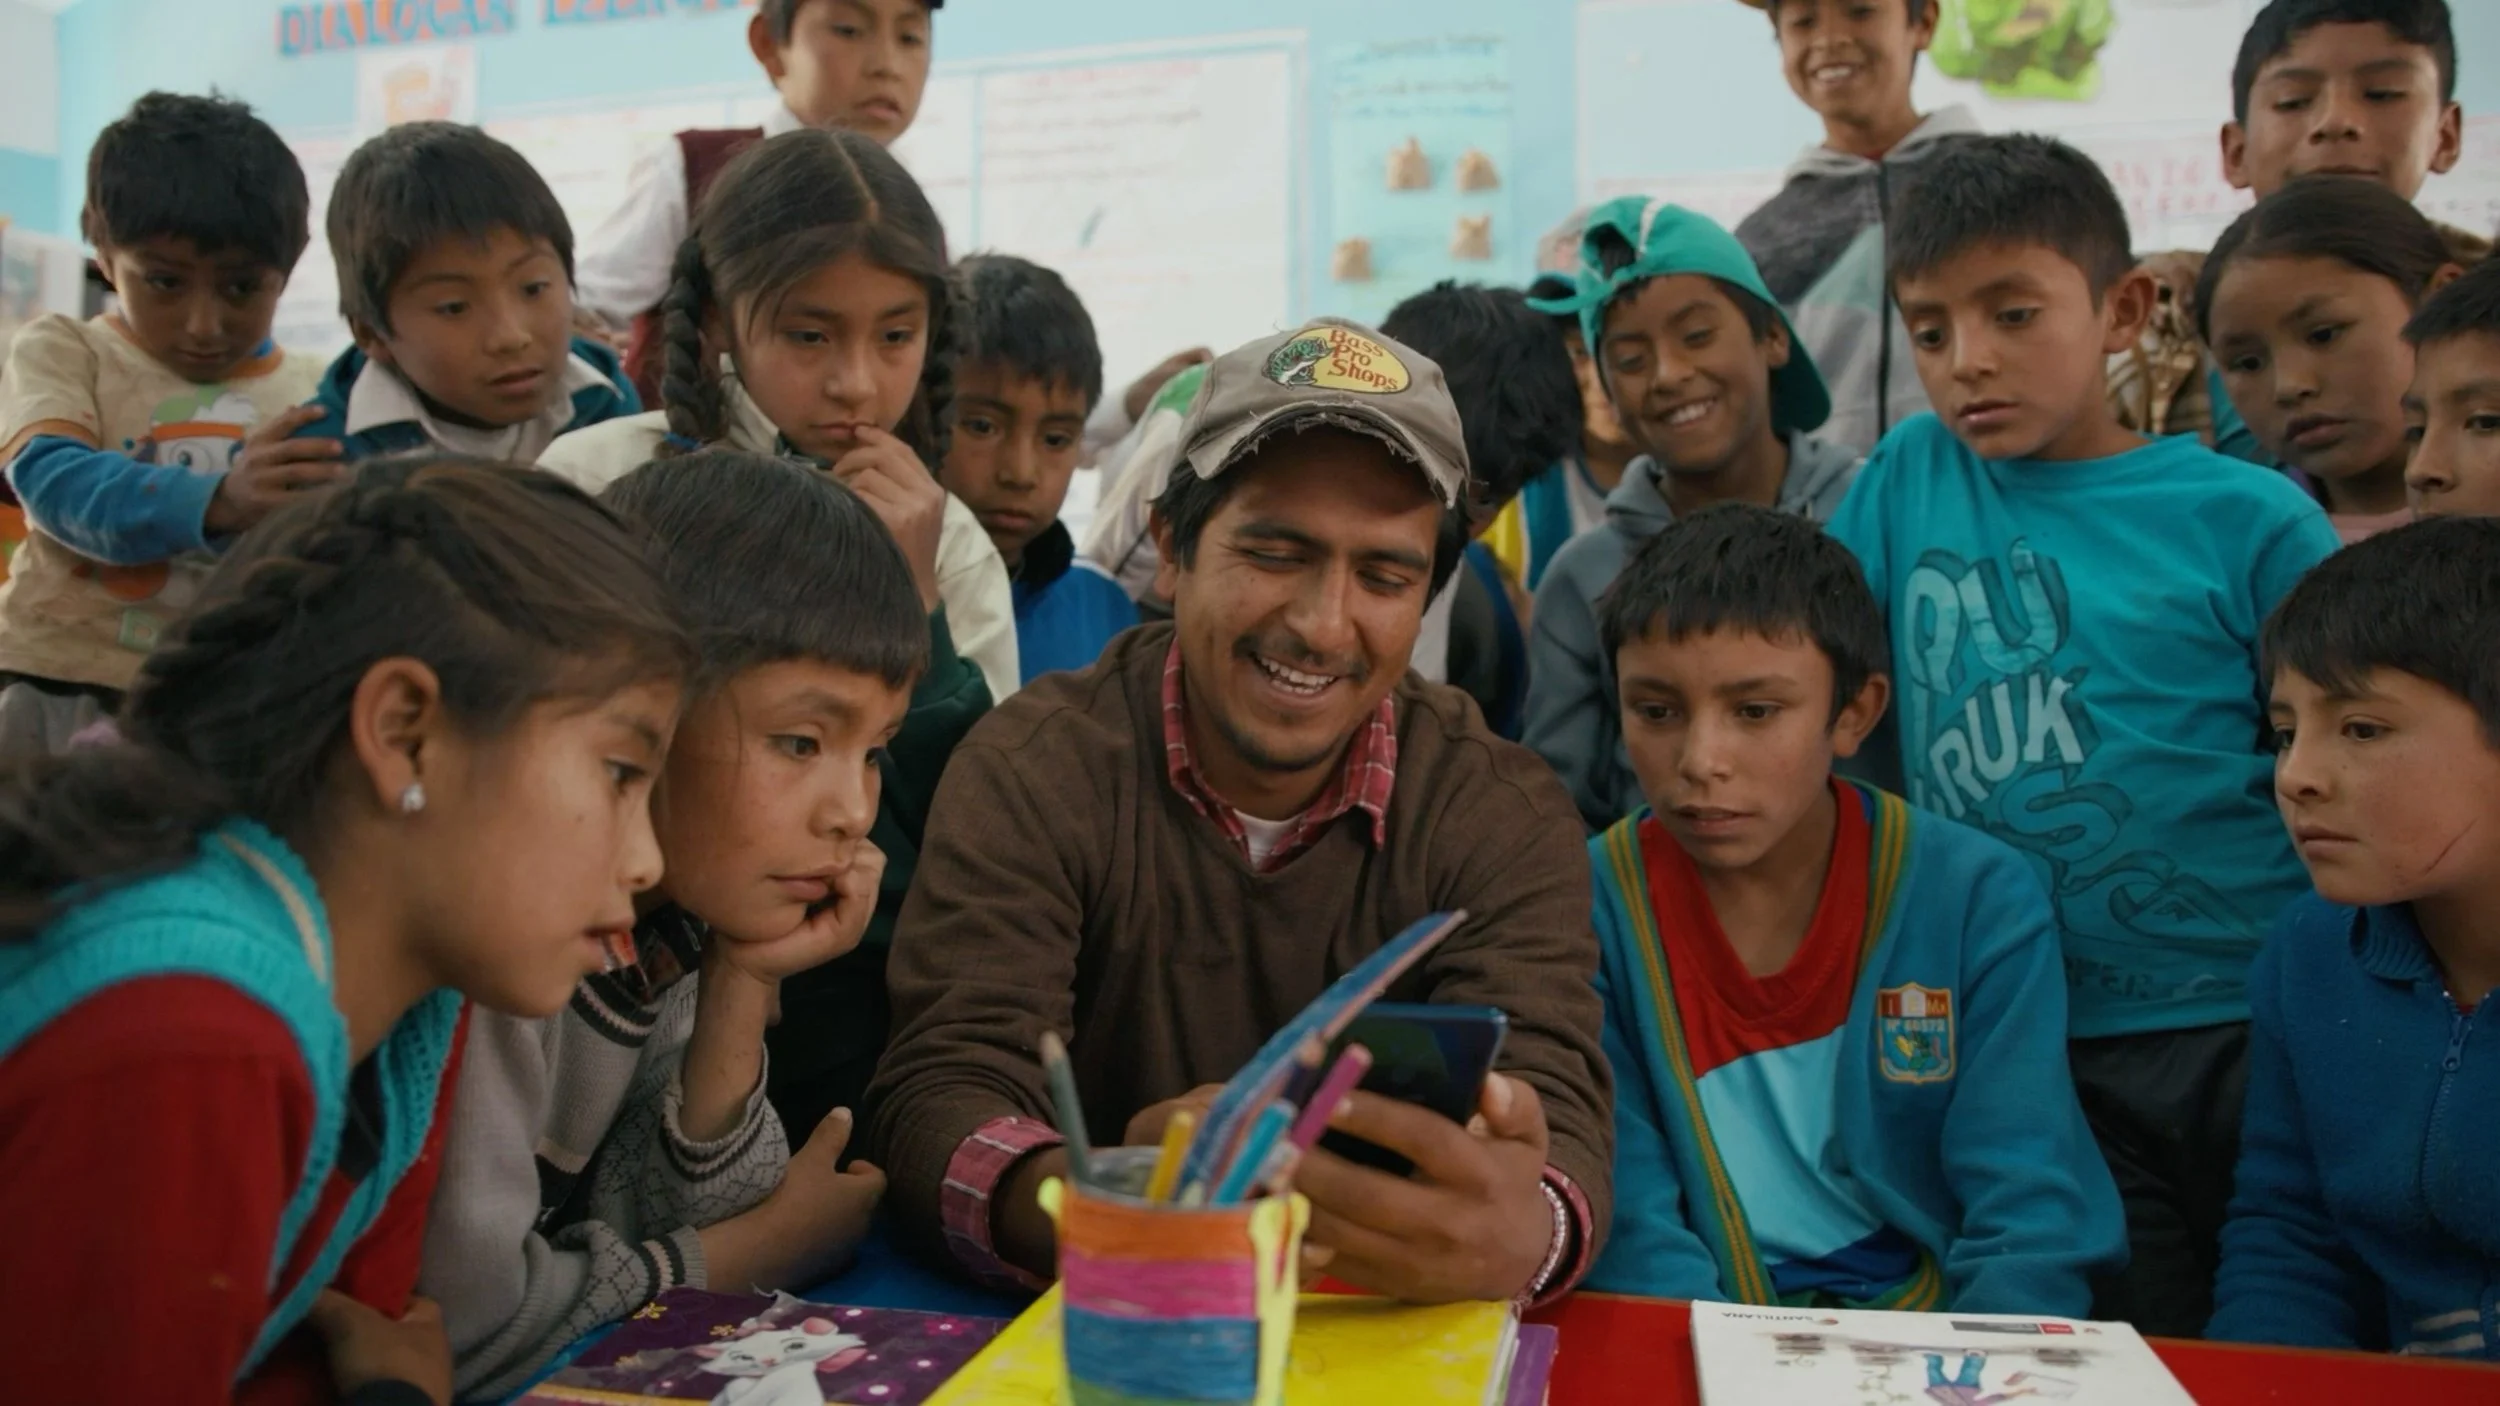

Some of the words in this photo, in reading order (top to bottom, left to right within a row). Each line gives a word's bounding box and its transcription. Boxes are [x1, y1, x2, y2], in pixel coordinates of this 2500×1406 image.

[1328, 329, 1384, 357] Bass
[1332, 343, 1372, 367] Pro
[1327, 359, 1398, 391] Shops
